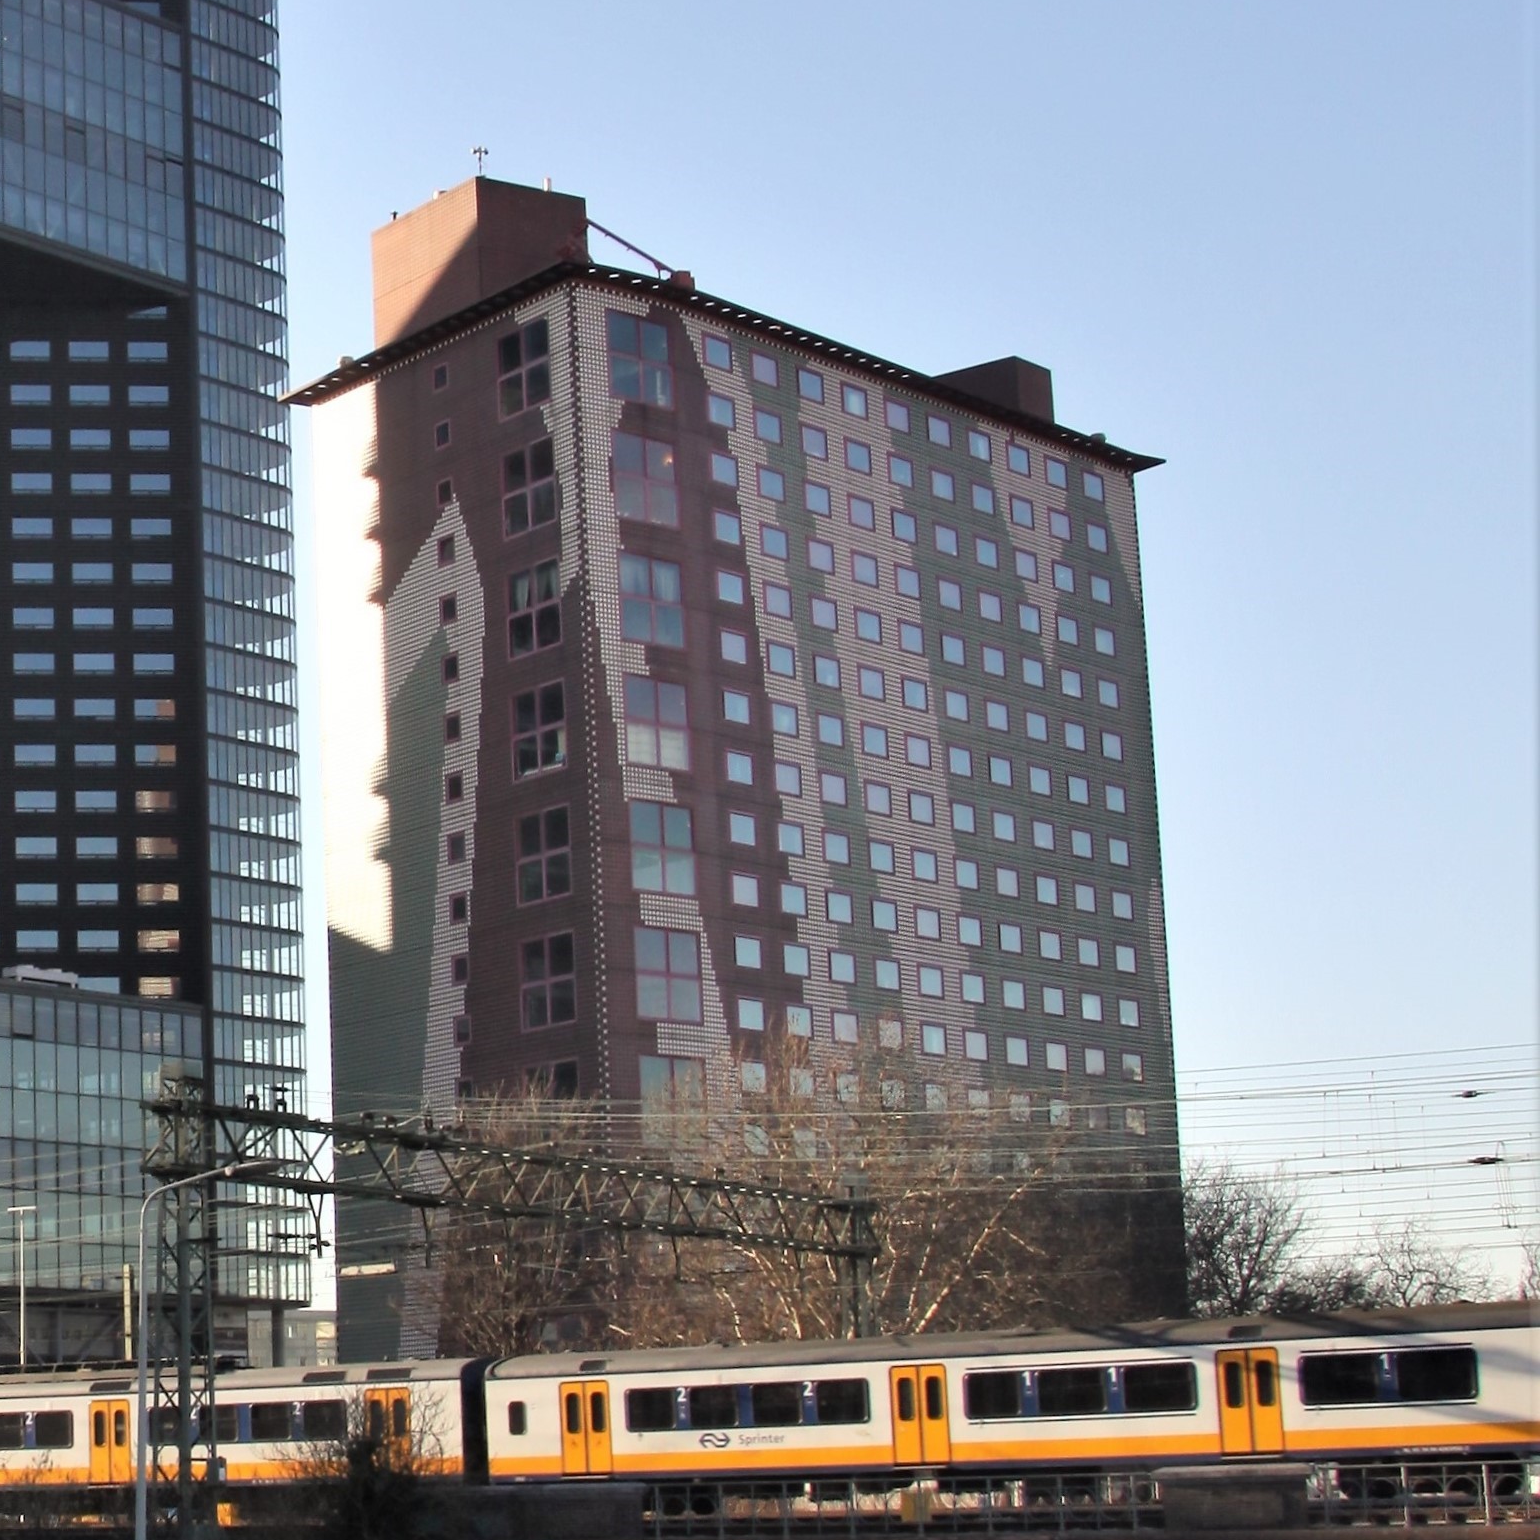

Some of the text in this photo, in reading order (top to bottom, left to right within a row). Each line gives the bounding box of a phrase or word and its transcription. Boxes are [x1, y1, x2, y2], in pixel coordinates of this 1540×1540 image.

[1380, 1353, 1389, 1369] 1
[1022, 1371, 1031, 1386] 1
[1108, 1367, 1116, 1382] 1
[676, 1387, 687, 1402] 2
[803, 1381, 813, 1397] 2
[190, 1406, 199, 1419] 2
[293, 1401, 301, 1415] 2
[25, 1412, 34, 1425] 2
[738, 1433, 785, 1446] Sprinter
